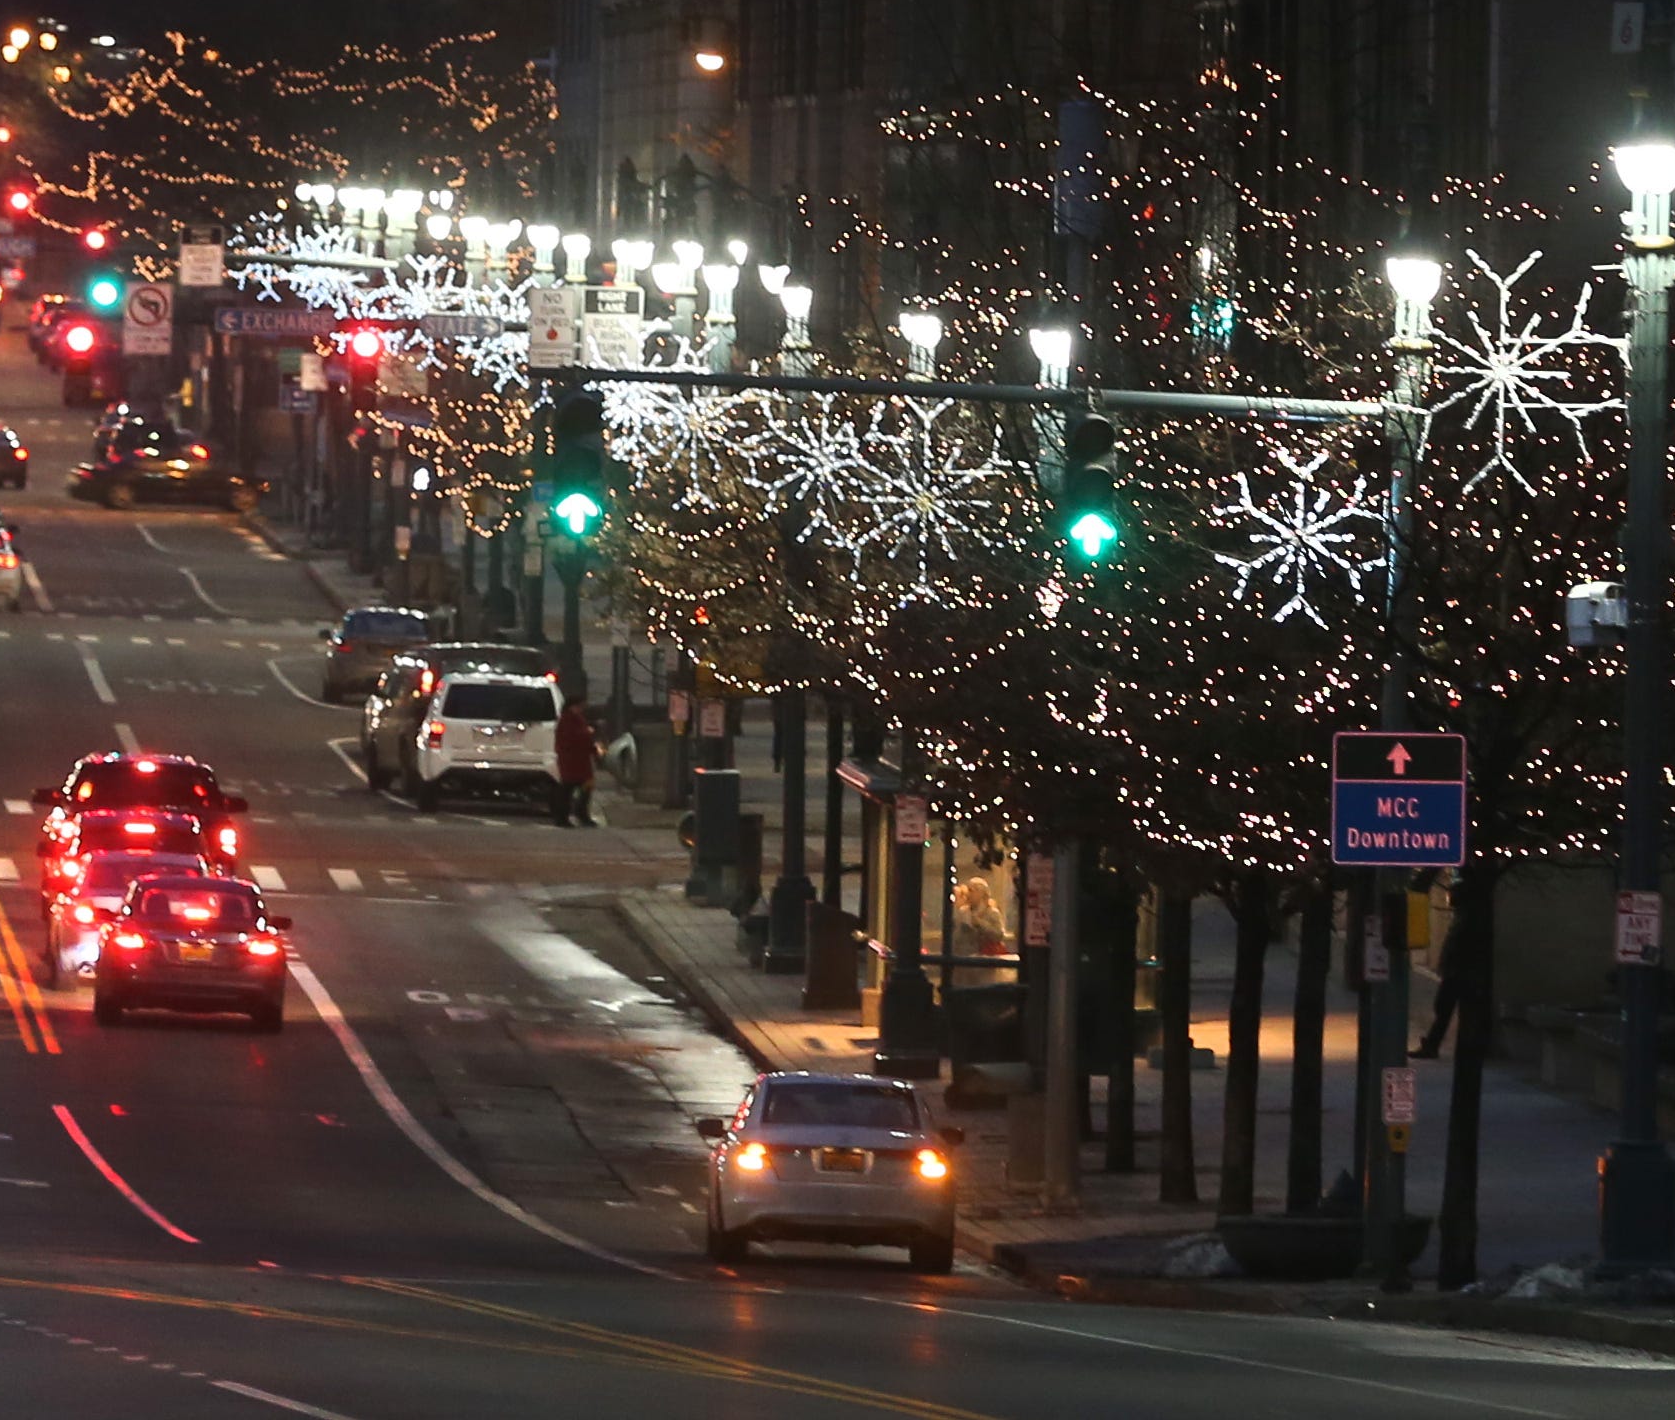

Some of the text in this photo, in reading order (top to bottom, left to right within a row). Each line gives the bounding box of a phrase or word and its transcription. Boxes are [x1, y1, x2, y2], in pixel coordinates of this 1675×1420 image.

[543, 292, 563, 304] NO
[596, 302, 627, 313] LANE
[242, 311, 333, 331] EXCHANGE
[1377, 797, 1420, 819] MCC
[1347, 828, 1451, 851] Downtown
[1627, 916, 1653, 930] ANY
[1624, 932, 1653, 946] TIME
